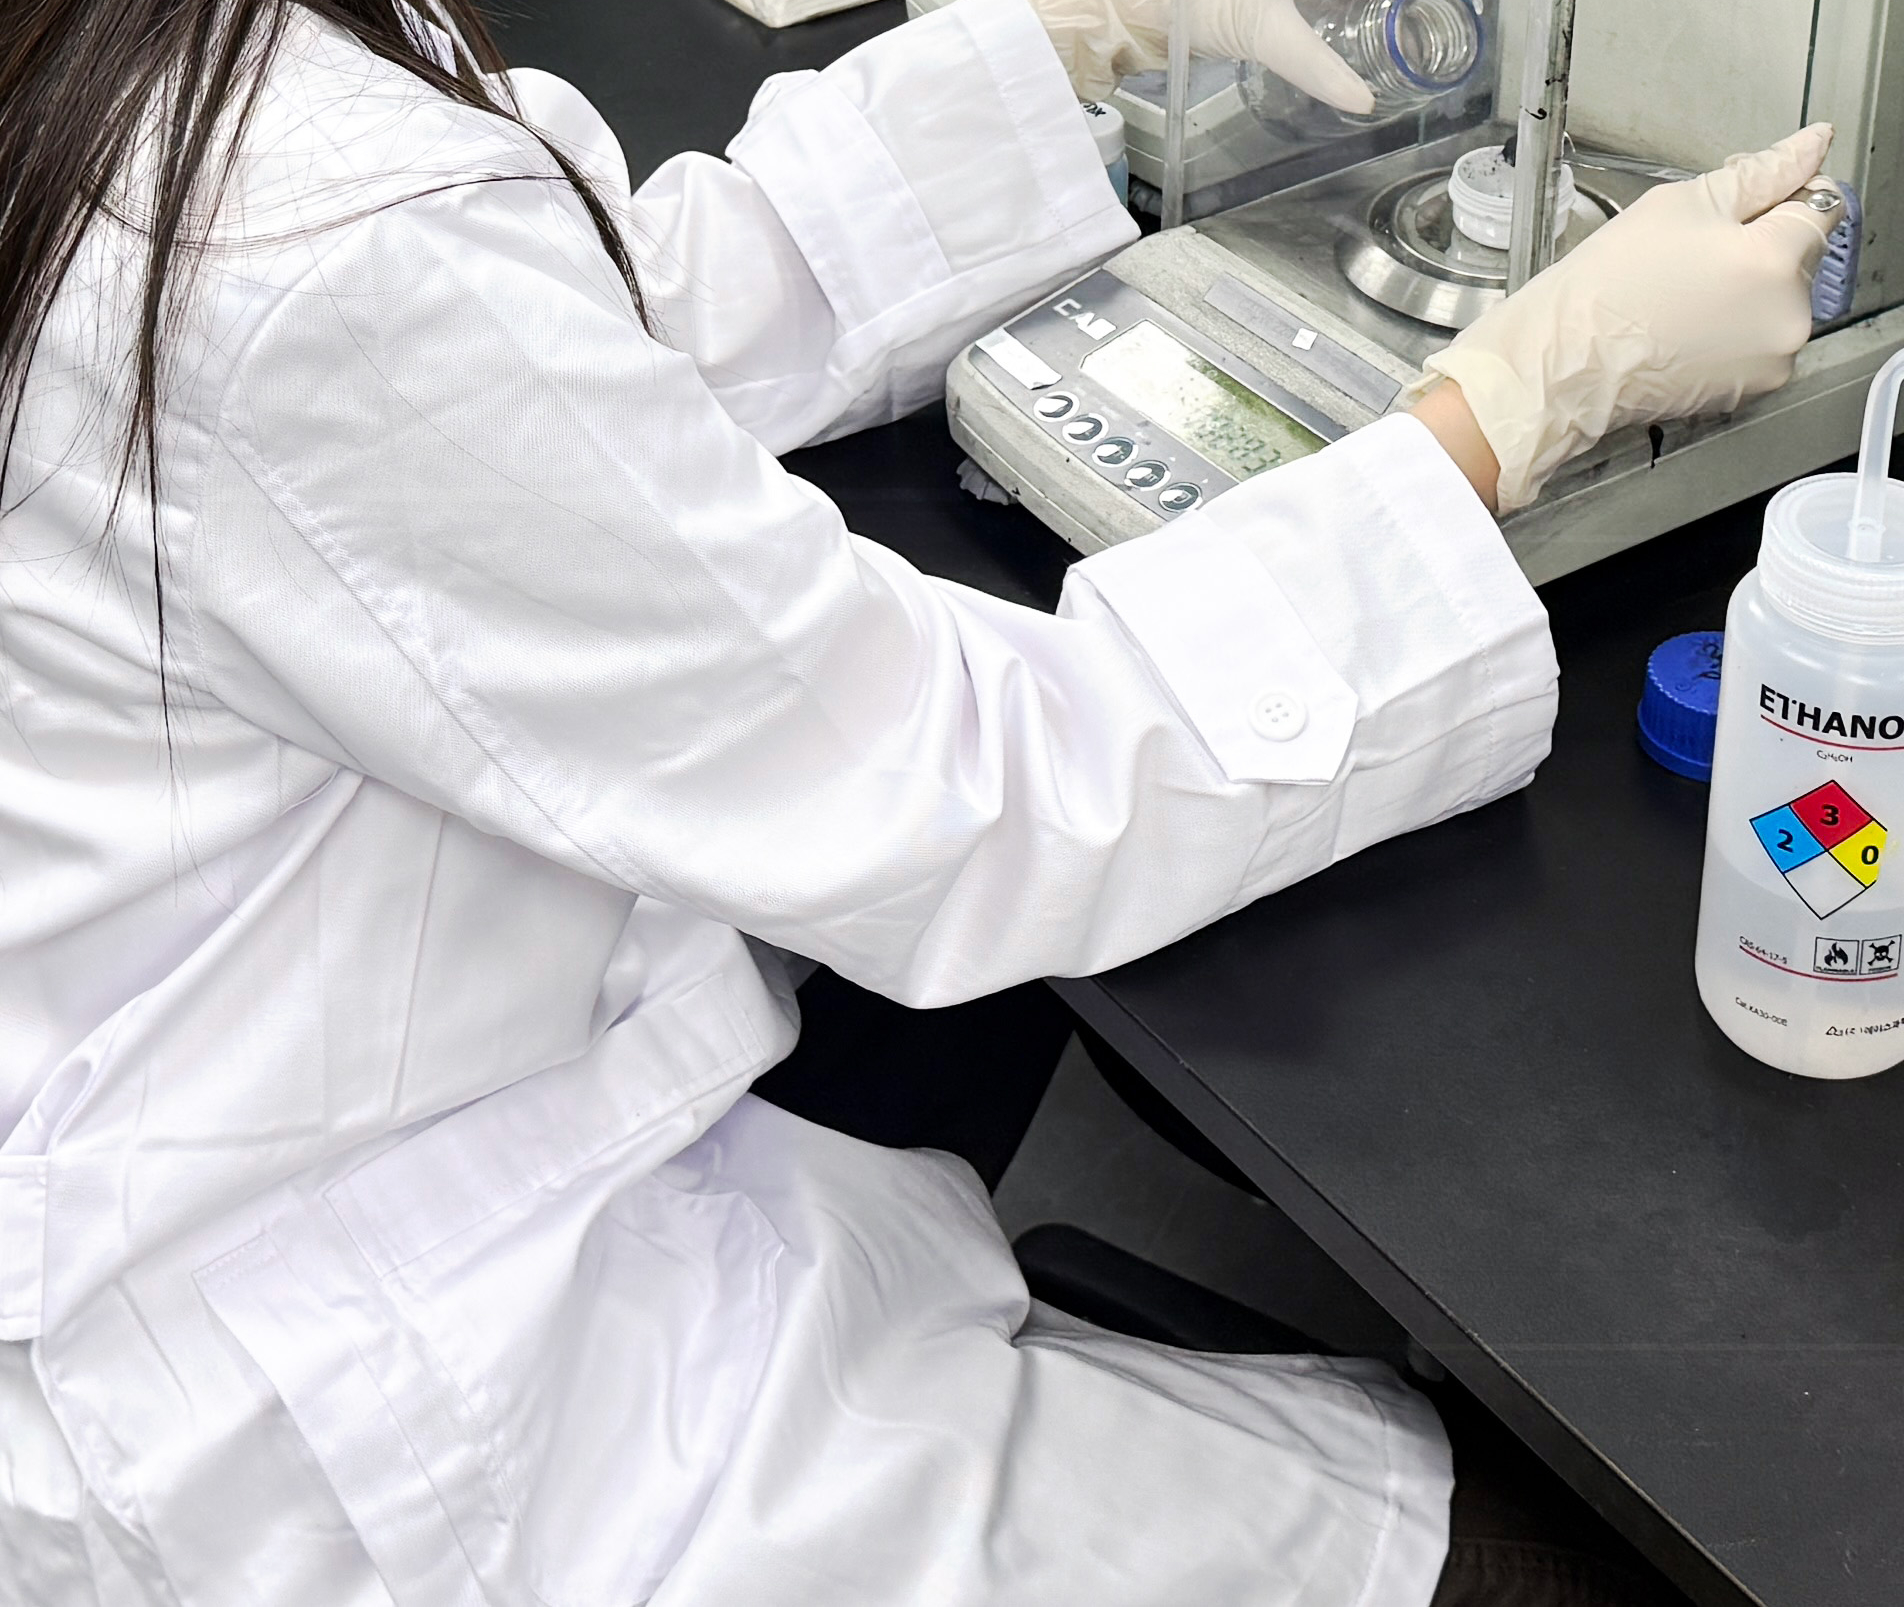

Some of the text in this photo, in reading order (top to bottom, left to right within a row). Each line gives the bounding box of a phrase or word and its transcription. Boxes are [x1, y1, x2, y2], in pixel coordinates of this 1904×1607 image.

[1819, 804, 1840, 826] 3
[1776, 828, 1794, 854] 2
[1861, 845, 1880, 866] 0
